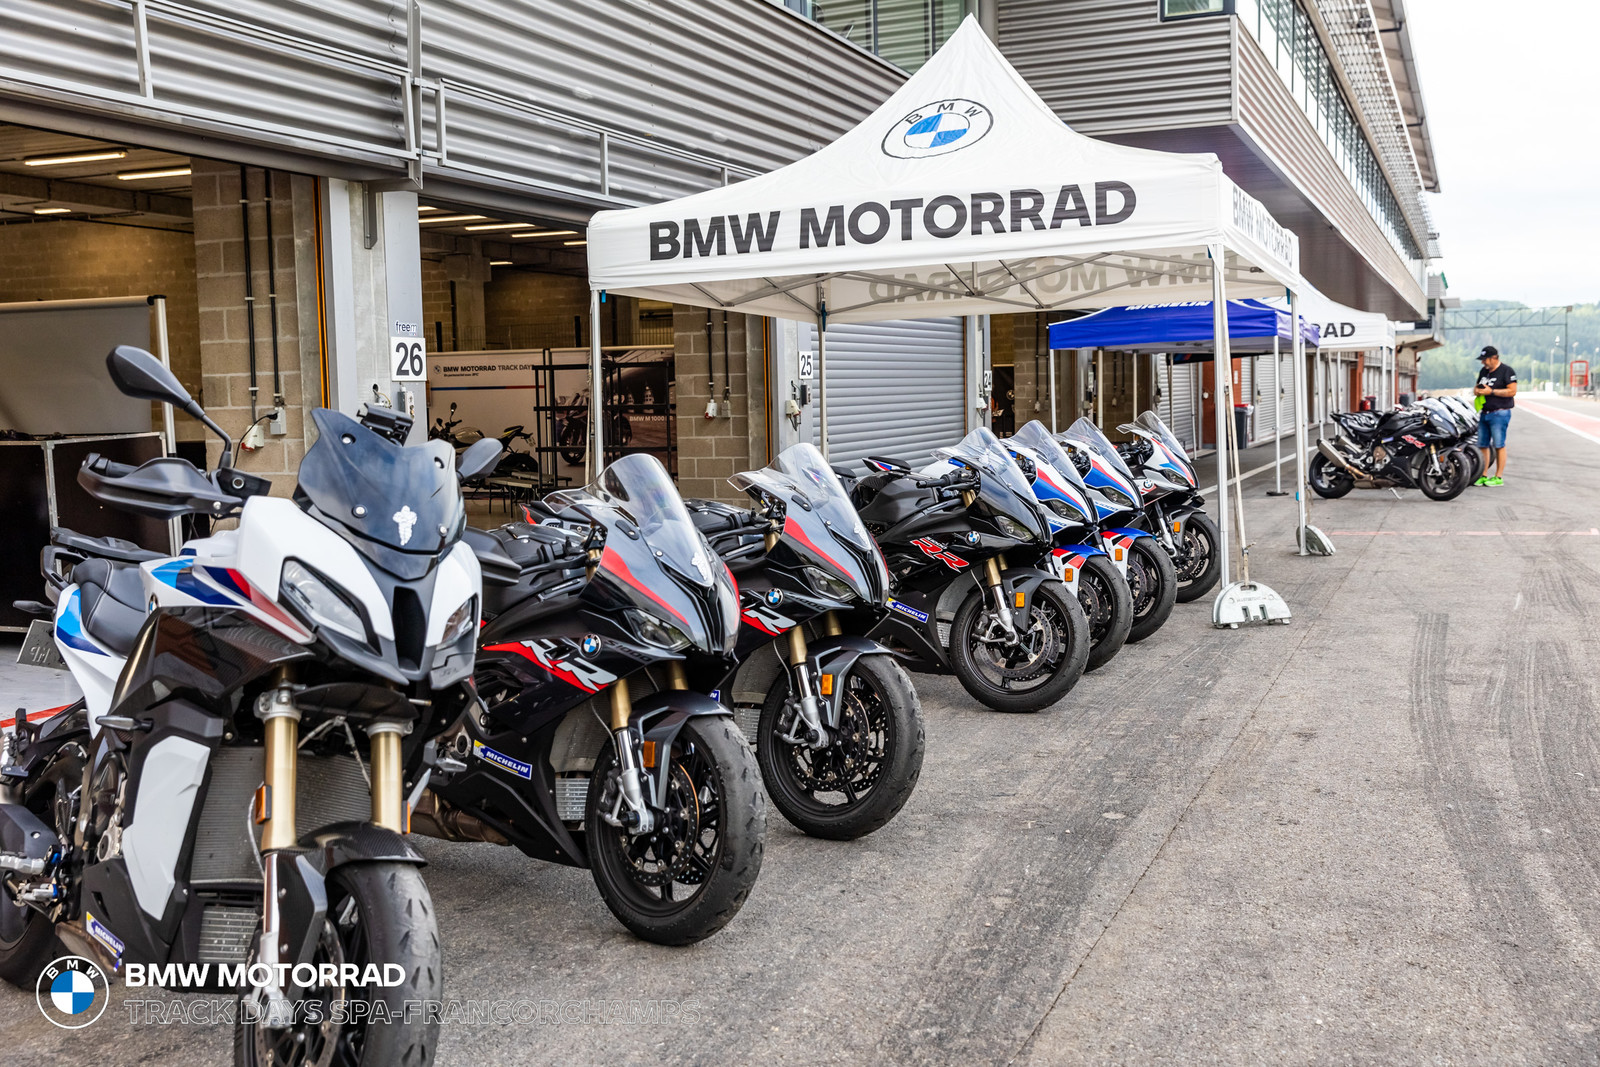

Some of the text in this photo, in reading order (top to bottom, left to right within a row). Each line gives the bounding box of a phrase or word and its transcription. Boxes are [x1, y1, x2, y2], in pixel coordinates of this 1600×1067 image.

[905, 102, 982, 125] BMW
[649, 180, 1137, 261] BMW MOTORRAD
[1125, 300, 1211, 311] MICHELIN
[395, 342, 424, 377] 26
[800, 355, 813, 377] 25
[909, 537, 970, 573] RR
[896, 603, 927, 620] MICHELIN
[486, 751, 529, 774] MICHELIN
[94, 925, 124, 954] MICHELIN
